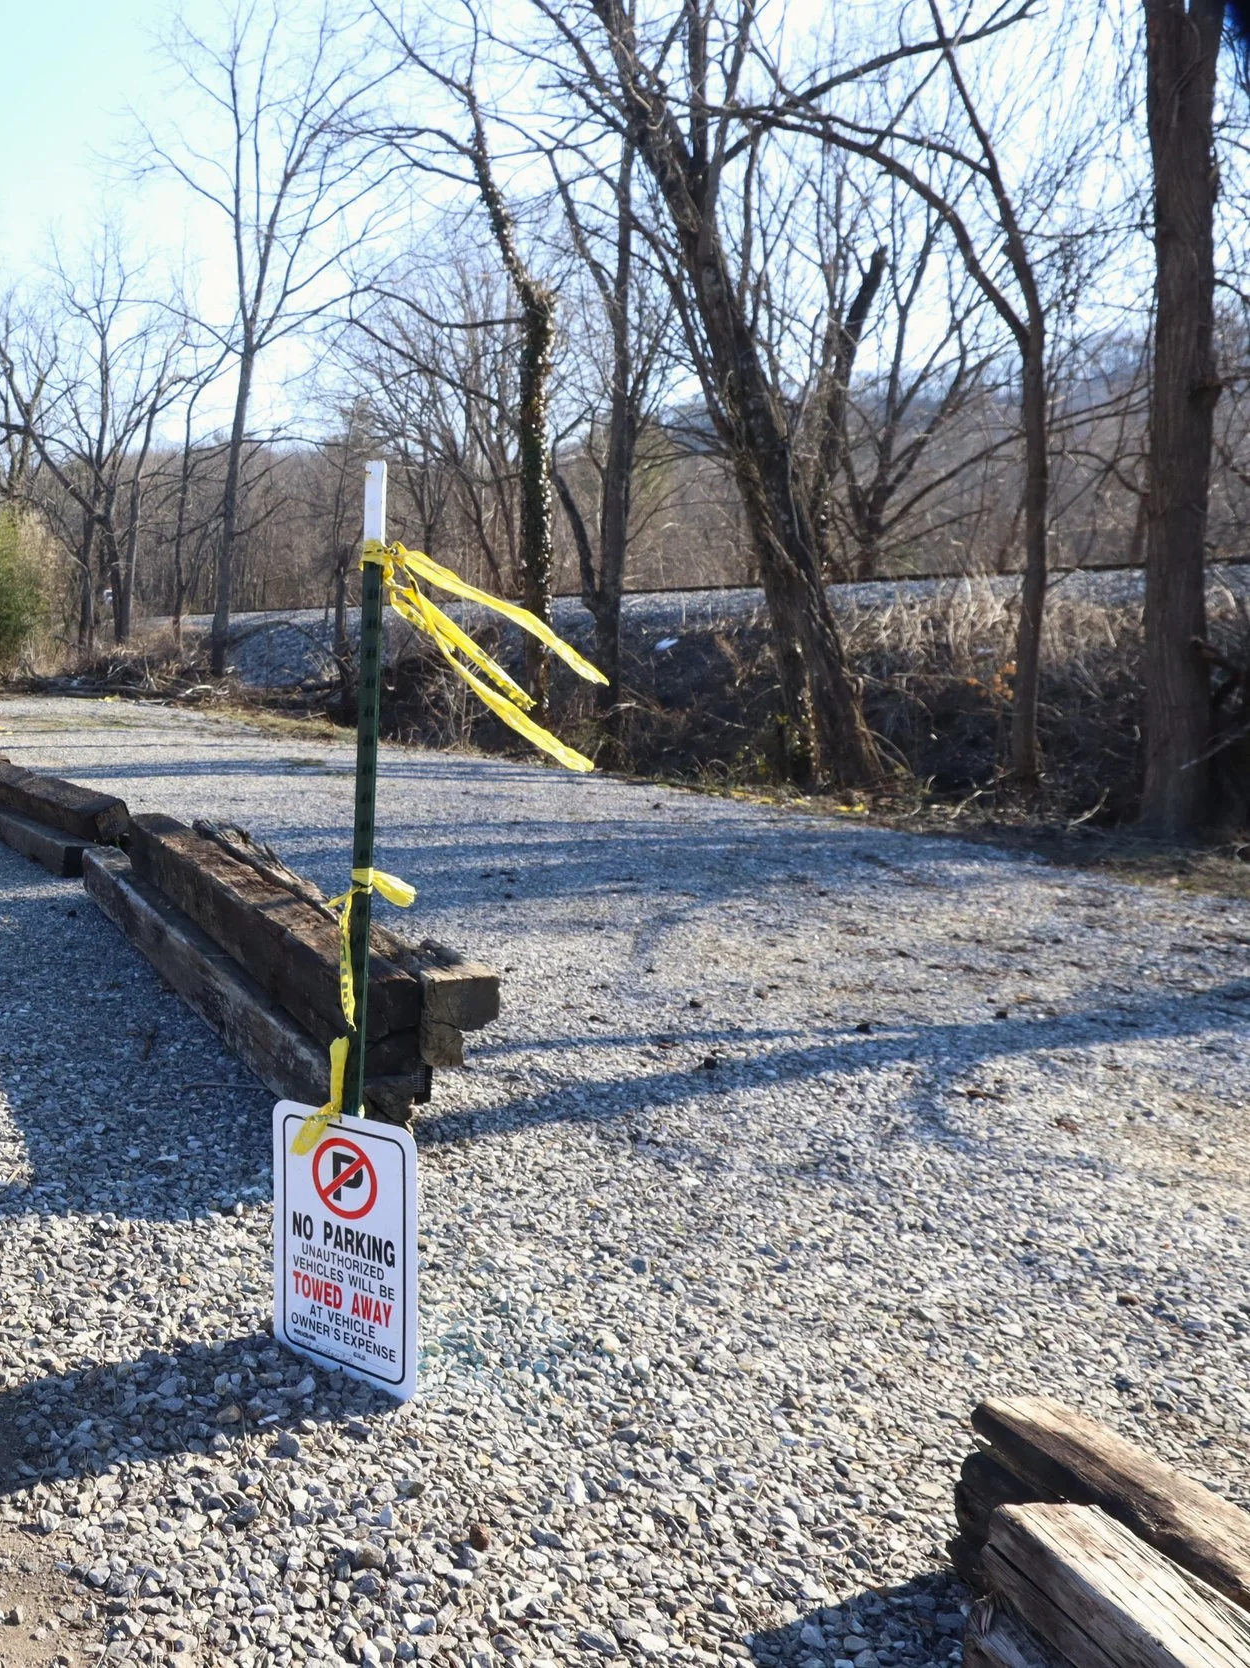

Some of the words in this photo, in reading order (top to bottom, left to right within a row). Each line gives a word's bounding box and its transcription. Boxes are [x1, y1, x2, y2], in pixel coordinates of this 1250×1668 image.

[292, 1211, 314, 1241] NO
[323, 1221, 396, 1268] PARKING
[301, 1242, 385, 1281] UNAUTHORIZED
[293, 1255, 344, 1283] VEHICLES
[348, 1274, 375, 1294] WILL
[380, 1285, 395, 1301] BE
[293, 1271, 342, 1310] TOWED
[351, 1293, 392, 1328] AWAY
[291, 1313, 341, 1342] OWNER'S
[343, 1335, 397, 1363] EXPENSE
[310, 1304, 323, 1318] AT
[328, 1309, 376, 1339] VEHICLE
